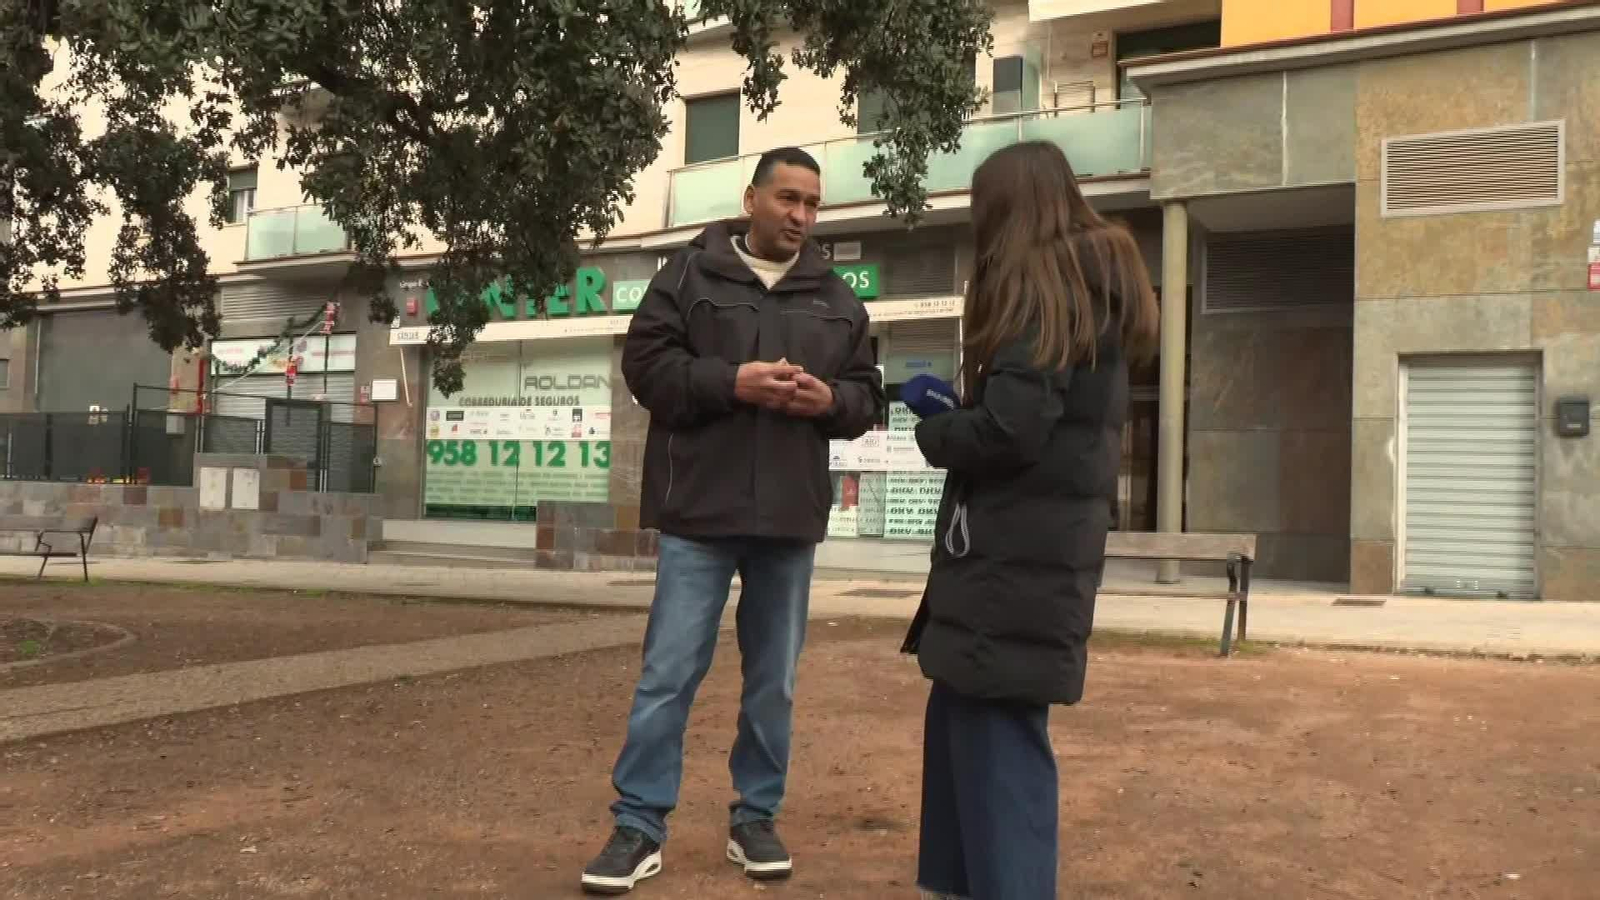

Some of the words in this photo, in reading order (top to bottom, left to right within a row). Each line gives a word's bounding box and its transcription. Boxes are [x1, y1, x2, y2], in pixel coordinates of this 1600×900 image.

[520, 396, 532, 407] DE
[535, 396, 580, 407] SEGUROS
[427, 440, 477, 467] 958
[488, 440, 520, 467] 12
[532, 440, 567, 468] 12
[579, 440, 611, 469] 13
